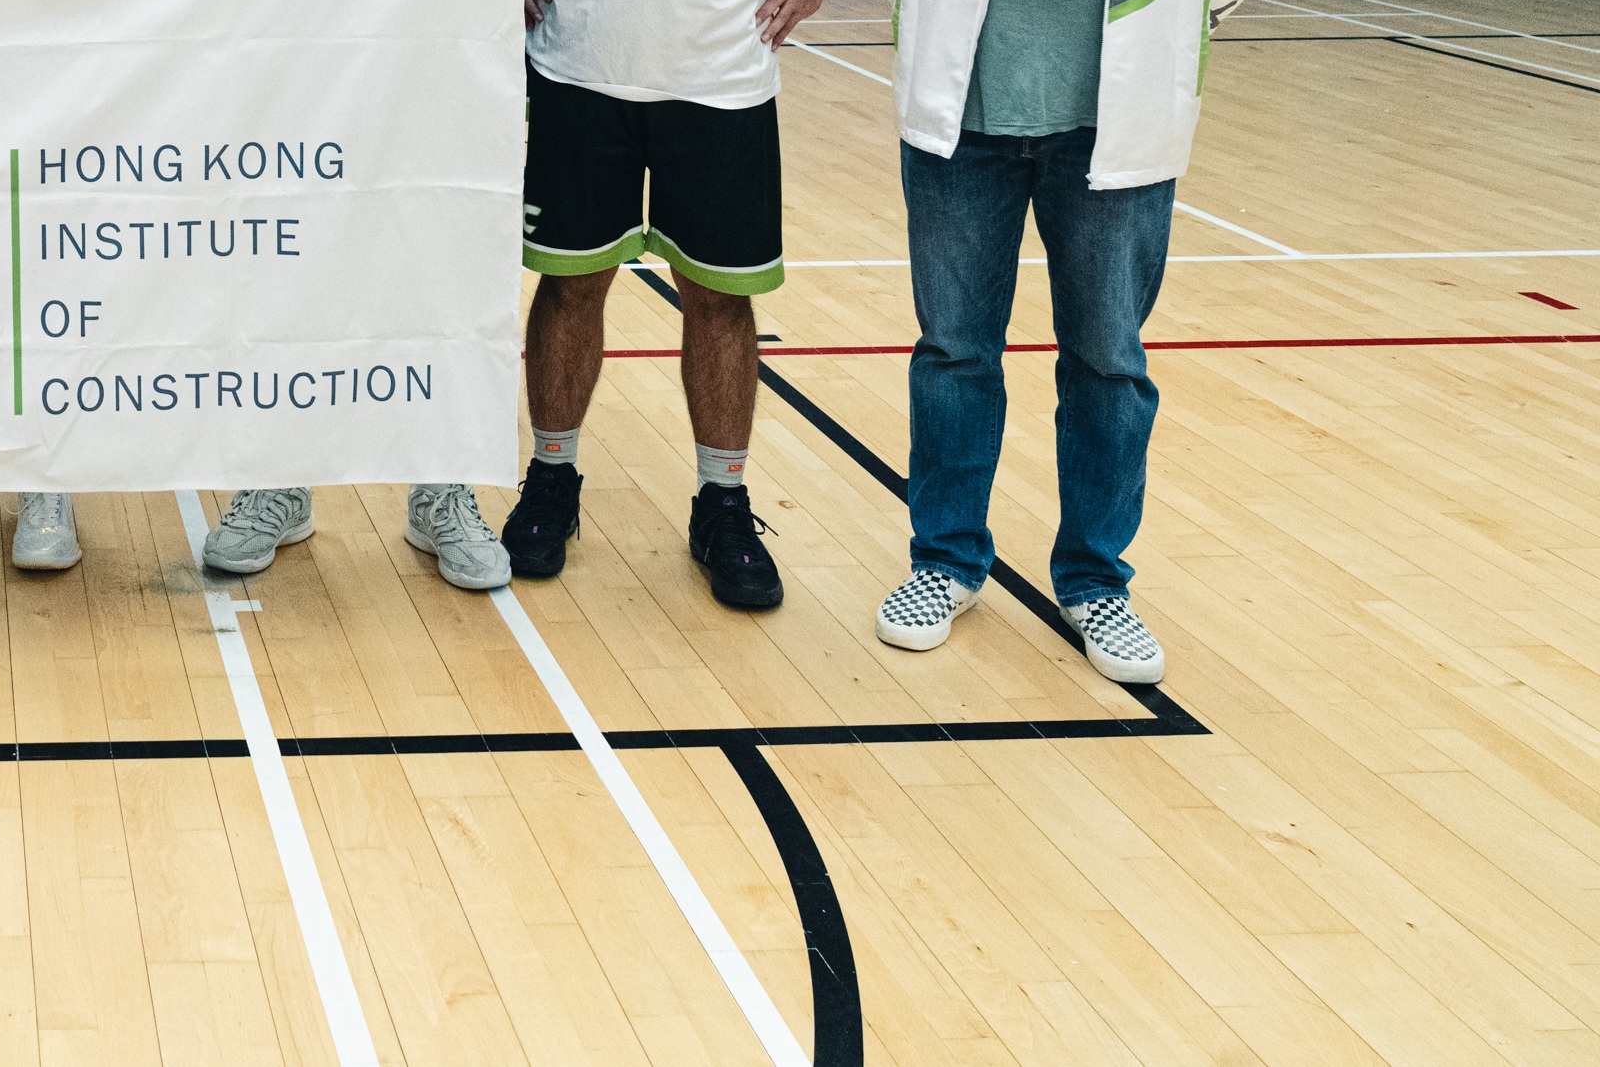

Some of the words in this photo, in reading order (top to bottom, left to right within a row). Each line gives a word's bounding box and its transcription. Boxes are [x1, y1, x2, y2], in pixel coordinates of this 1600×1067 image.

[40, 144, 183, 184] HONG
[203, 141, 346, 181] KONG
[40, 219, 301, 261] INSTITUTE
[40, 300, 103, 338] OF
[41, 364, 434, 416] CONSTRUCTION
